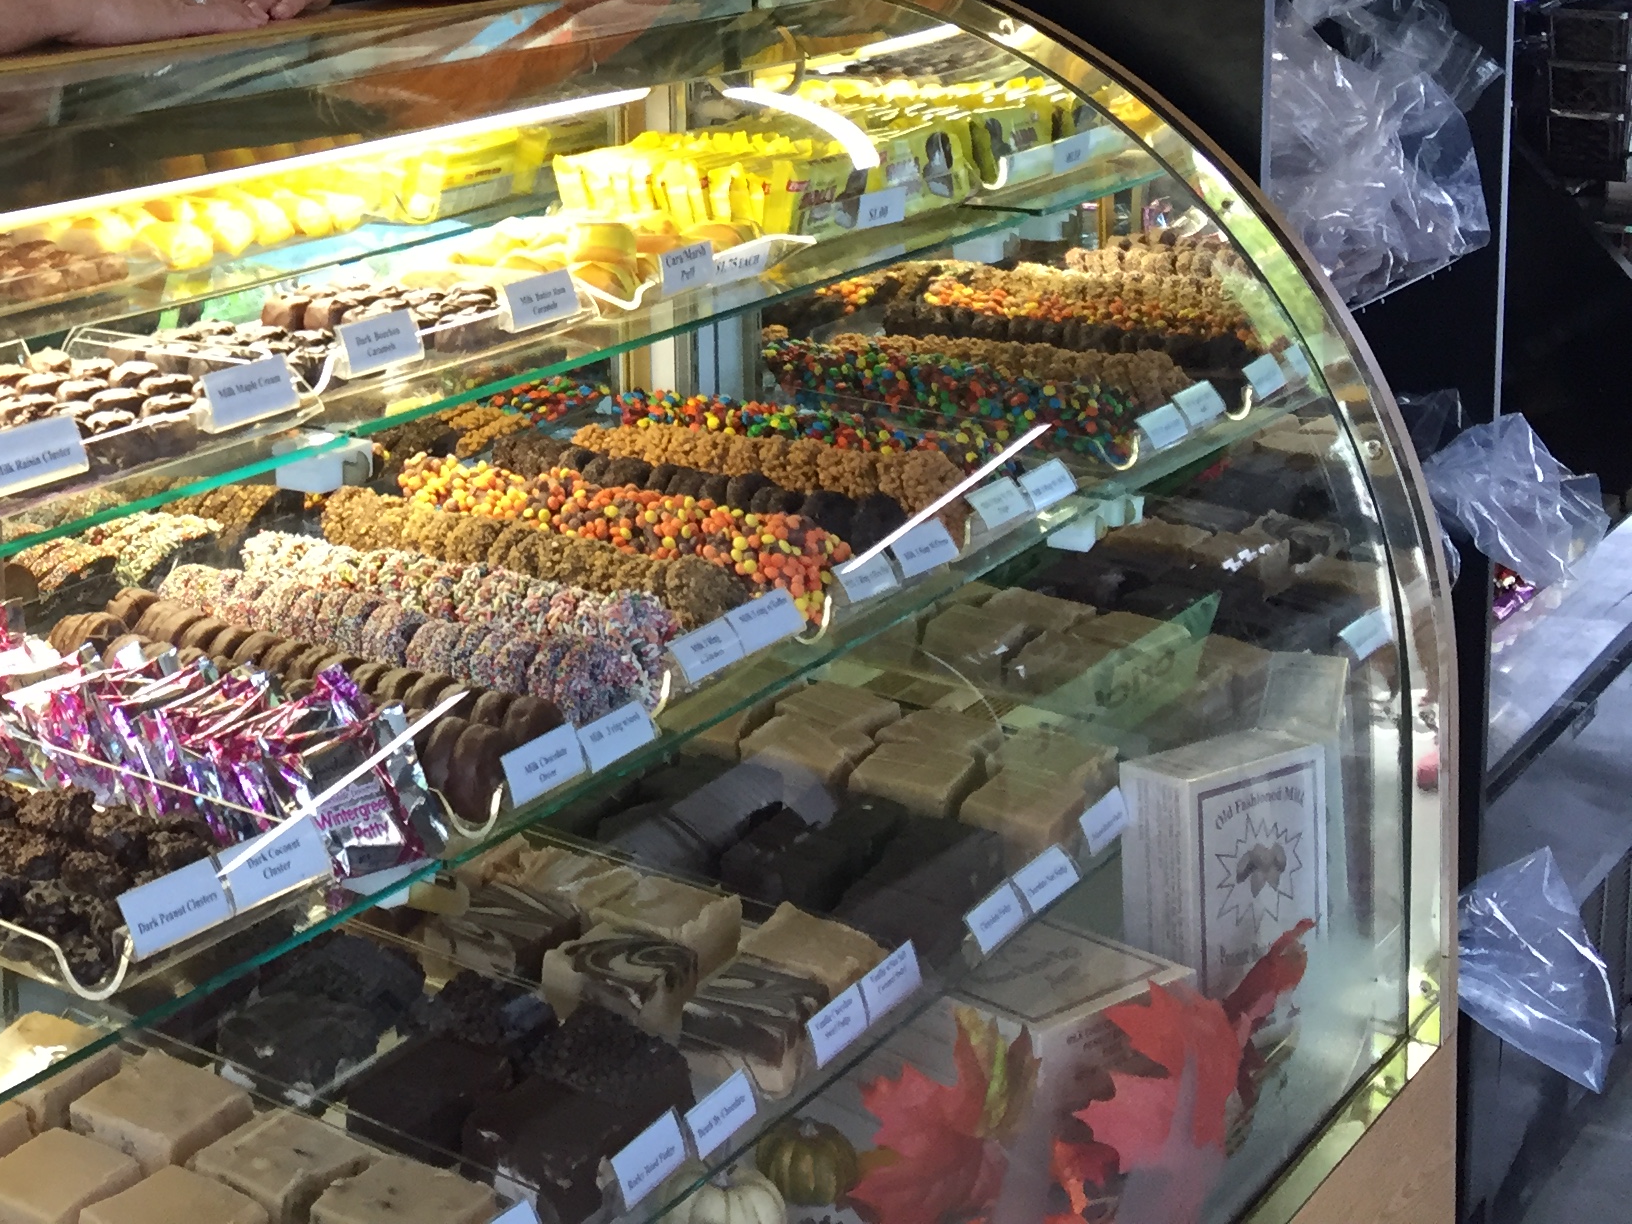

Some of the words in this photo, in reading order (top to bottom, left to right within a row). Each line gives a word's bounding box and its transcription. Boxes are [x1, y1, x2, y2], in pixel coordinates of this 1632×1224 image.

[1214, 807, 1233, 831] Old
[1234, 788, 1283, 817] Fashioned
[246, 853, 268, 870] Dark
[267, 837, 301, 860] Coconut
[262, 859, 292, 881] Cluster
[137, 918, 159, 936] Dark
[159, 904, 187, 925] Peanut
[187, 890, 218, 912] Clusters
